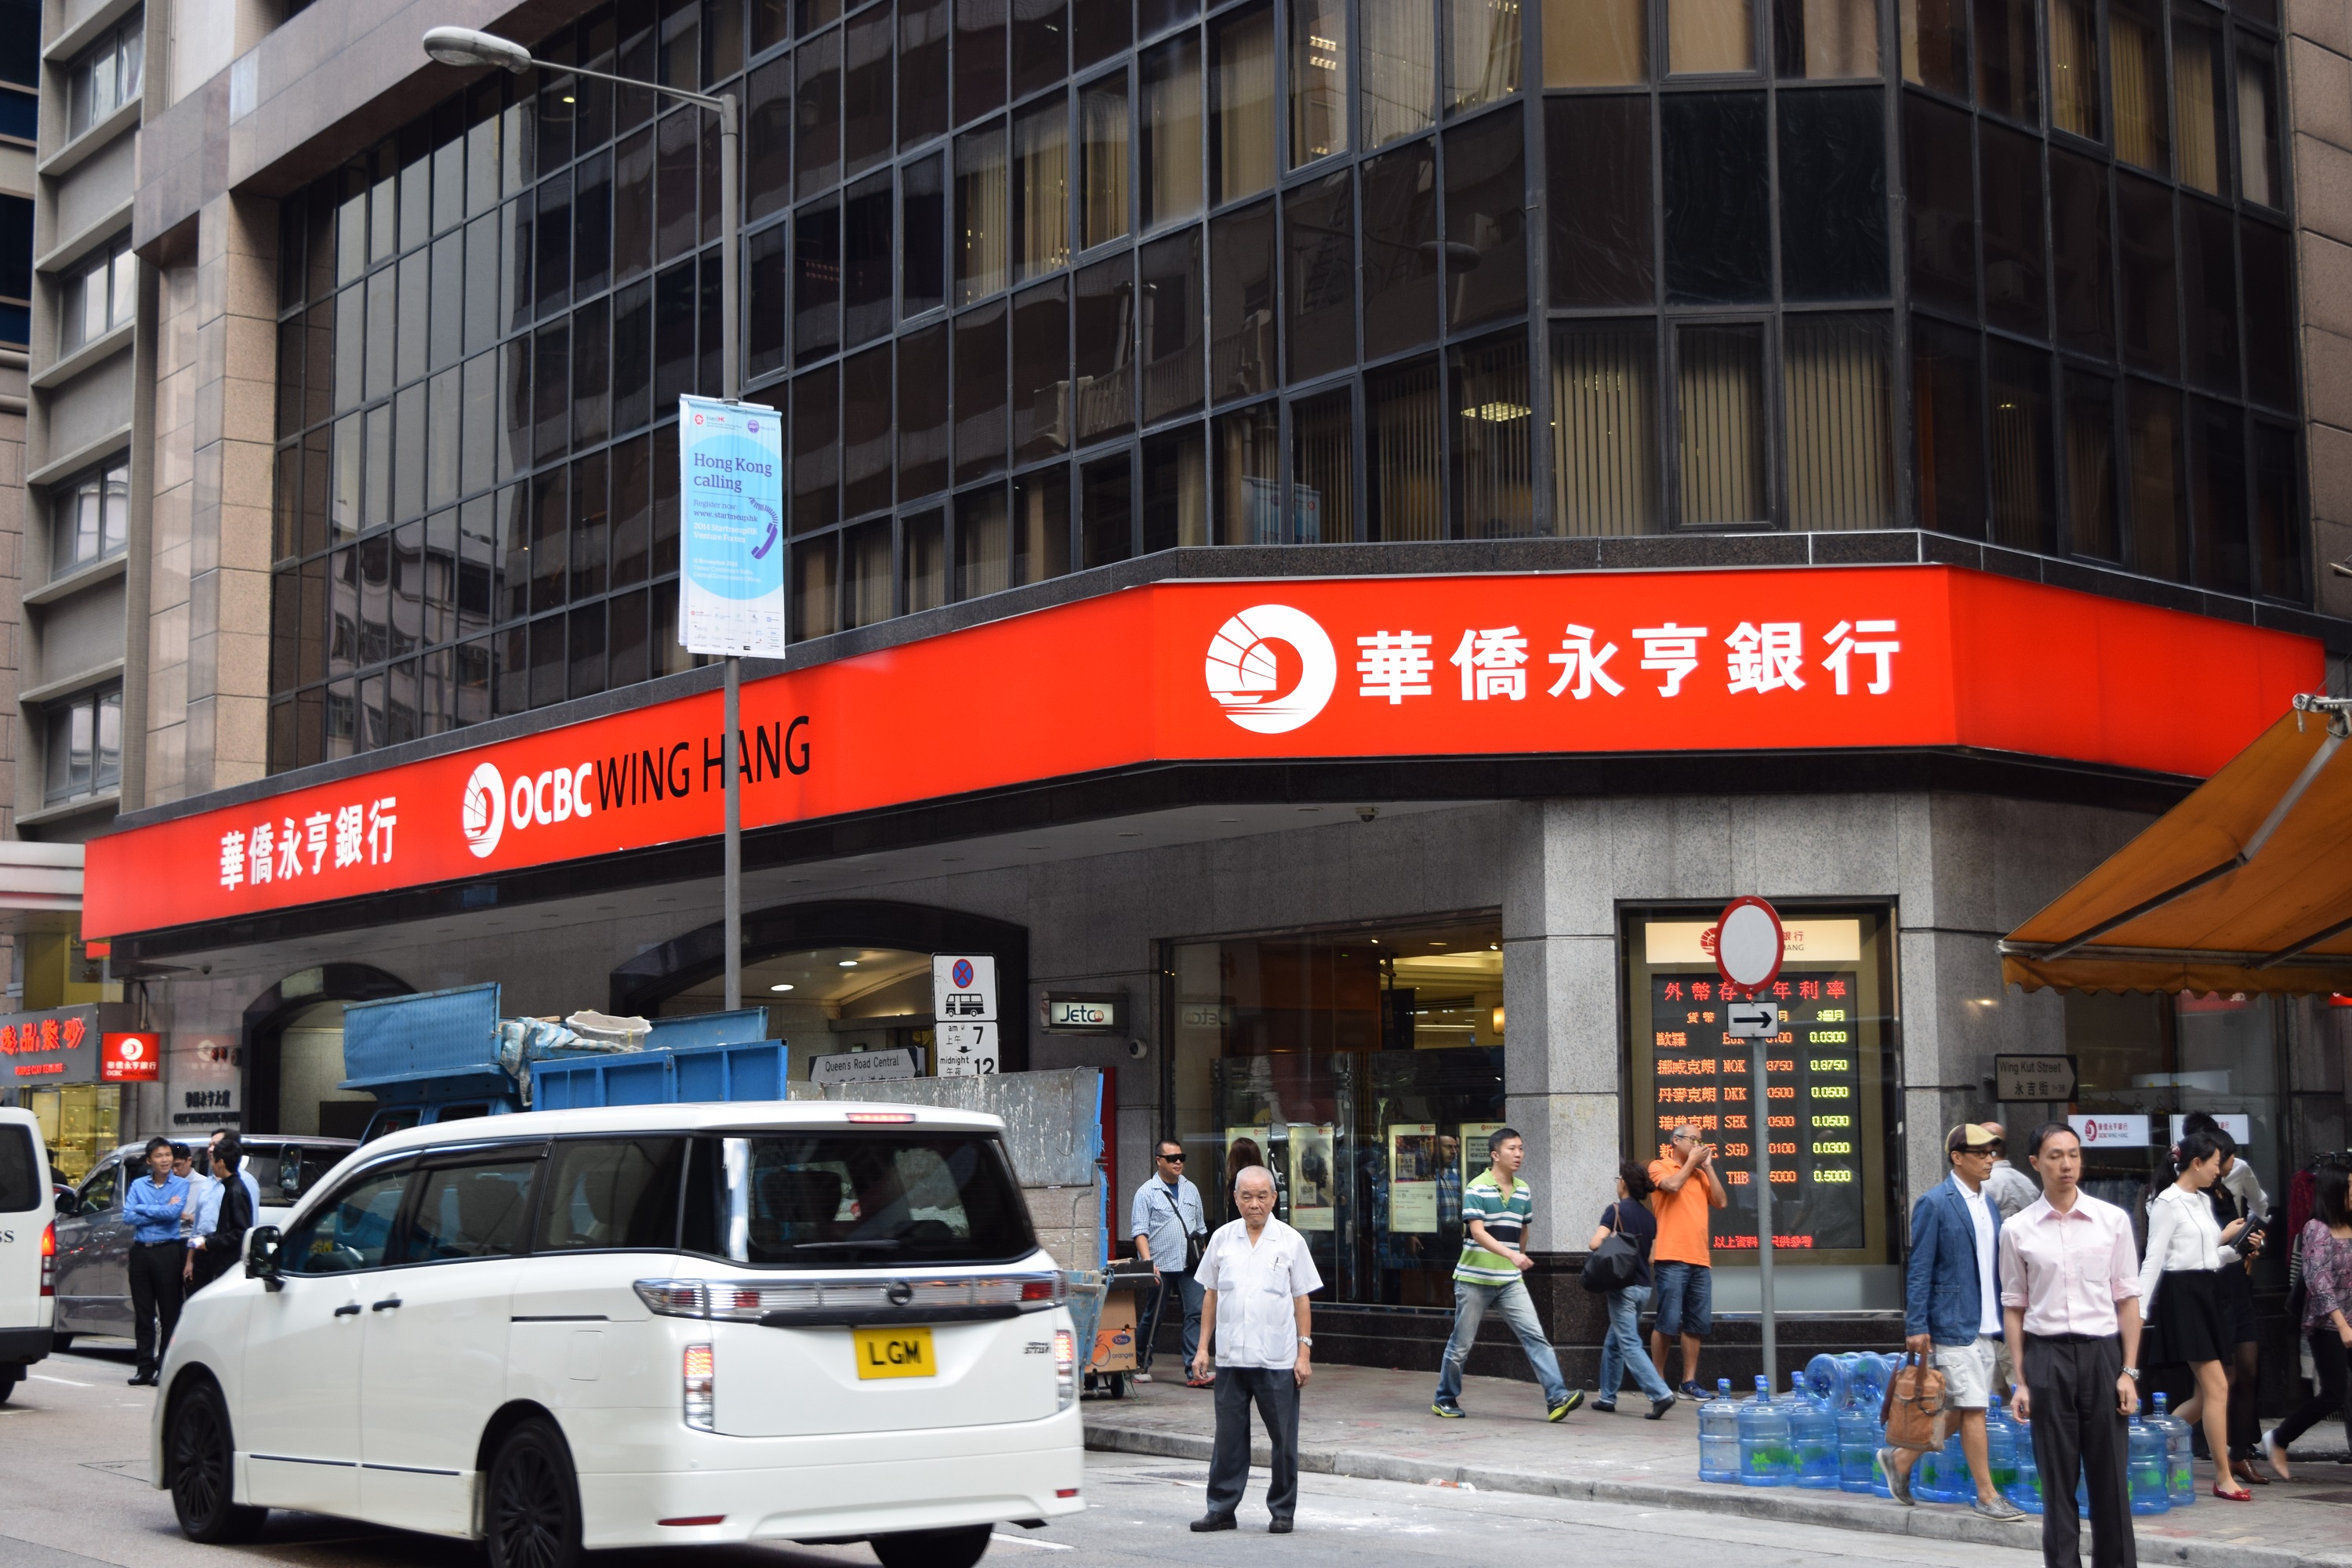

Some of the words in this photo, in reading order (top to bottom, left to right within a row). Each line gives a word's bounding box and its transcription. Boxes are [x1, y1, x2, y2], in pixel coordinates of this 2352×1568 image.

[694, 452, 732, 473] Hong
[735, 457, 772, 477] Kong
[694, 474, 742, 493] calling
[694, 499, 720, 510] Register
[693, 522, 710, 531] 2014
[694, 532, 722, 541] Venture
[723, 534, 746, 543] Forum
[1356, 619, 1900, 704] 華僑永亨銀行
[510, 762, 593, 830] OCBC
[597, 741, 690, 811] WING
[703, 715, 811, 793] HANG
[220, 796, 397, 891] 華僑永亨銀行
[1664, 980, 1846, 1002] 外幣存年利率
[946, 1035, 961, 1045] 上午
[973, 1026, 984, 1044] 7
[1809, 1031, 1846, 1044] 0.0300
[826, 1061, 851, 1073] Queen's
[855, 1058, 871, 1069] Road
[873, 1055, 900, 1067] Central
[940, 1056, 970, 1066] midnight
[974, 1058, 995, 1075] 12
[1722, 1059, 1747, 1073] NOK
[1809, 1059, 1848, 1072] 0.8750
[1998, 1061, 2019, 1075] Wing
[2020, 1061, 2034, 1073] Kut
[2037, 1061, 2061, 1073] Street
[1723, 1087, 1748, 1101] DKK
[1810, 1087, 1849, 1098] 0.0500
[2014, 1080, 2049, 1096] 永吉街
[1724, 1115, 1748, 1129] SEK
[1812, 1115, 1849, 1127] 0.0500
[1725, 1143, 1749, 1156] SGD
[1813, 1142, 1850, 1153] 0.0300
[1726, 1171, 1750, 1185] THB
[1813, 1171, 1851, 1182] 0.5000
[867, 1340, 922, 1366] LGM
